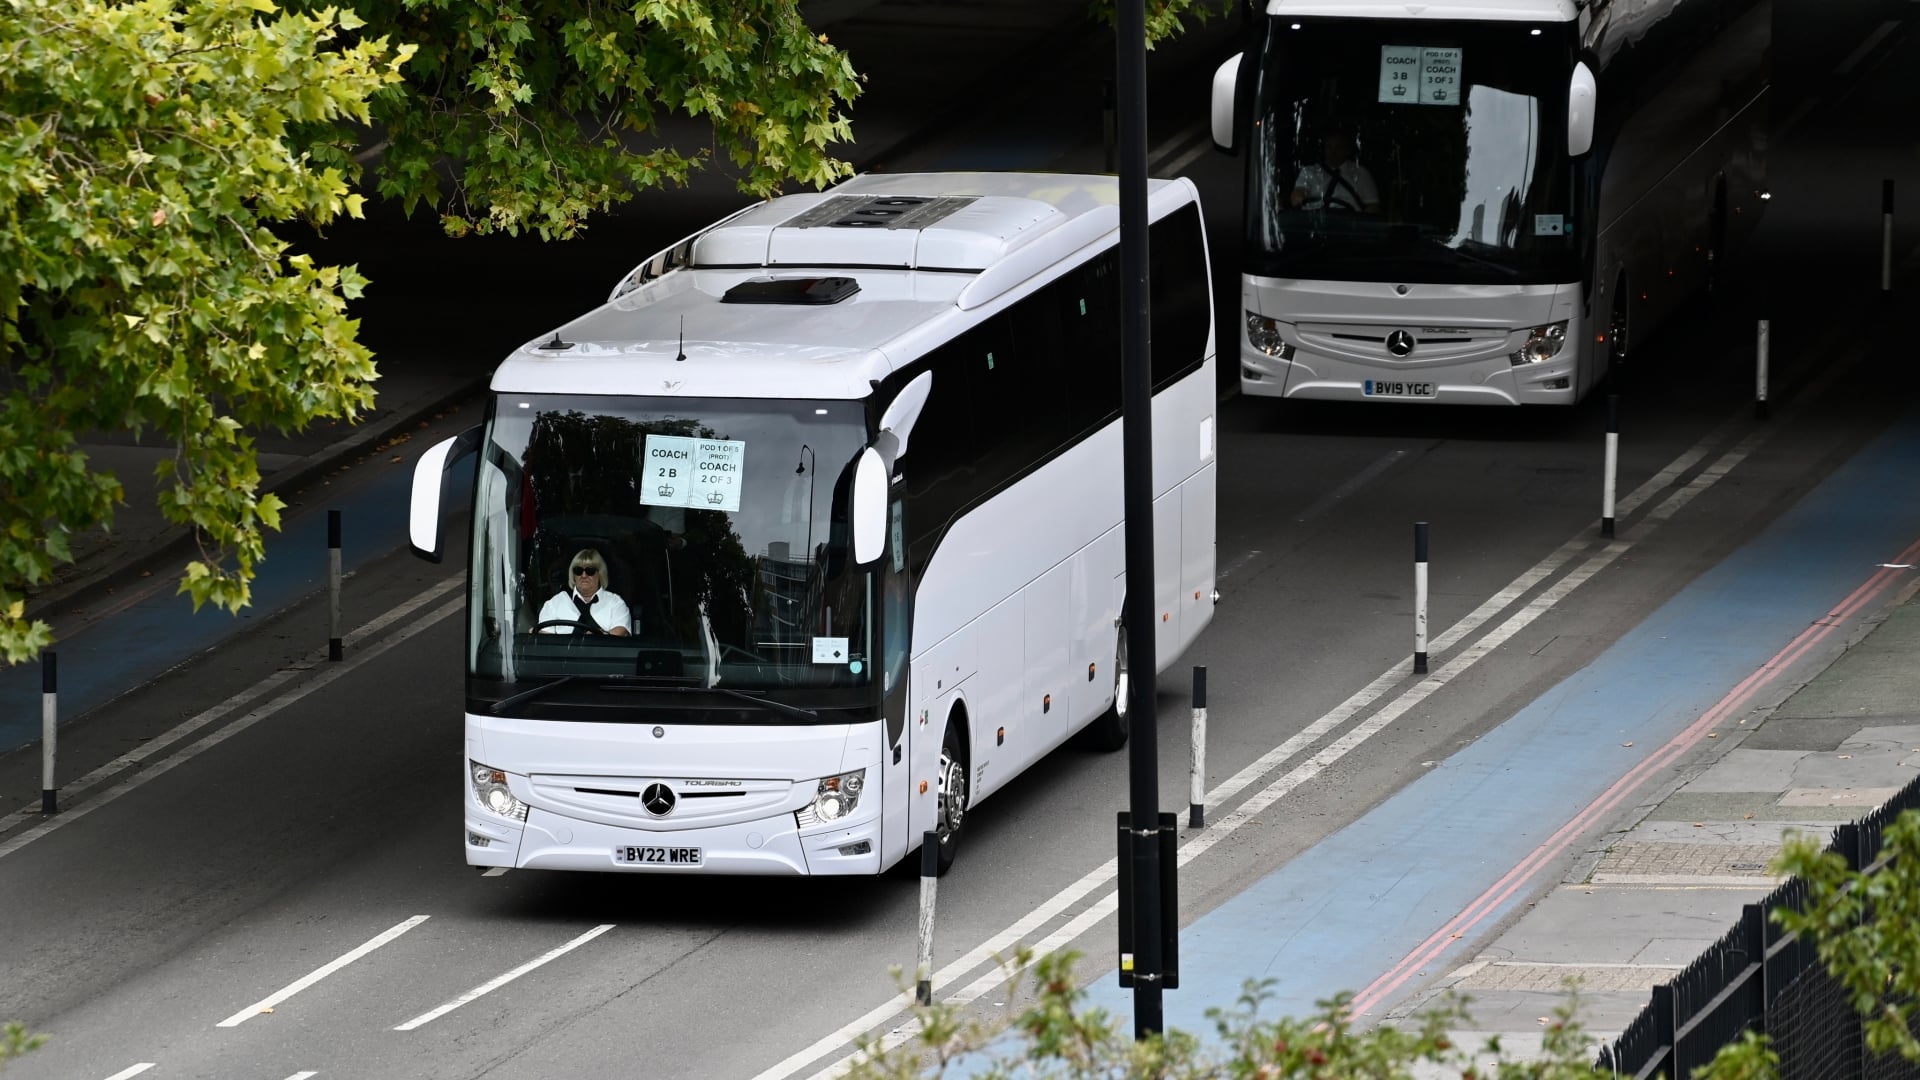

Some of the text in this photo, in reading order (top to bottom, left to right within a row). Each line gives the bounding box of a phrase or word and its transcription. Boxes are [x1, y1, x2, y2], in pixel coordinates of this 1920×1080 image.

[1386, 56, 1416, 64] COACH
[1392, 72, 1408, 80] 3 B
[1376, 382, 1430, 395] BV19 YGC
[652, 448, 688, 460] COACH
[700, 462, 736, 472] COACH
[658, 468, 677, 478] 2 B
[701, 475, 732, 484] 2 OF 3
[626, 848, 699, 863] BV22 WRE
